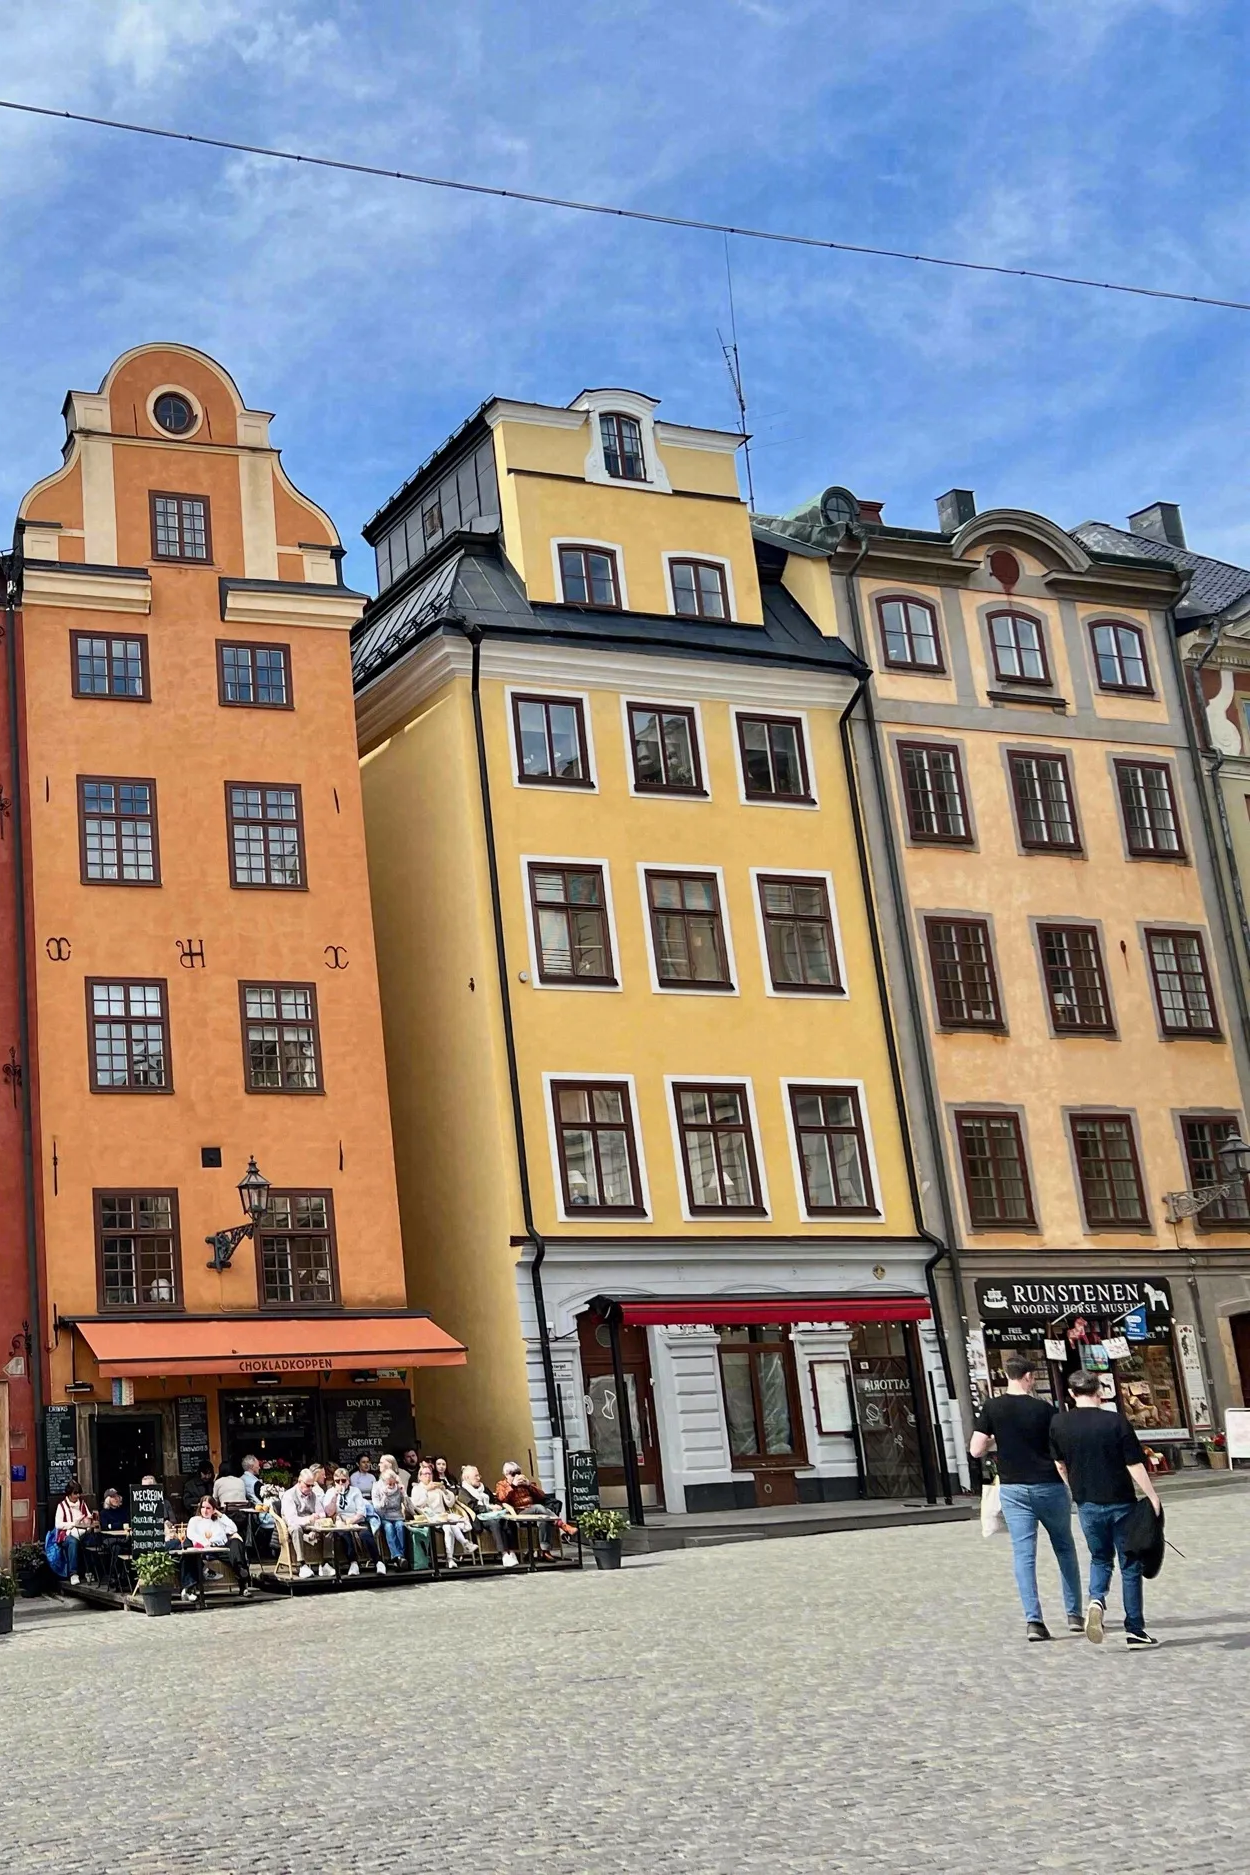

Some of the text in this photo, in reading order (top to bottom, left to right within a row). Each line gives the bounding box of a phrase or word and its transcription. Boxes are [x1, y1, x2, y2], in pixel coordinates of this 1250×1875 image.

[1012, 1284, 1139, 1302] RUNSTENEN
[1011, 1302, 1142, 1314] WOODEN HORSE MUSEU
[239, 1359, 332, 1371] CHOKLADKOPPEN
[569, 1454, 593, 1466] TAKE
